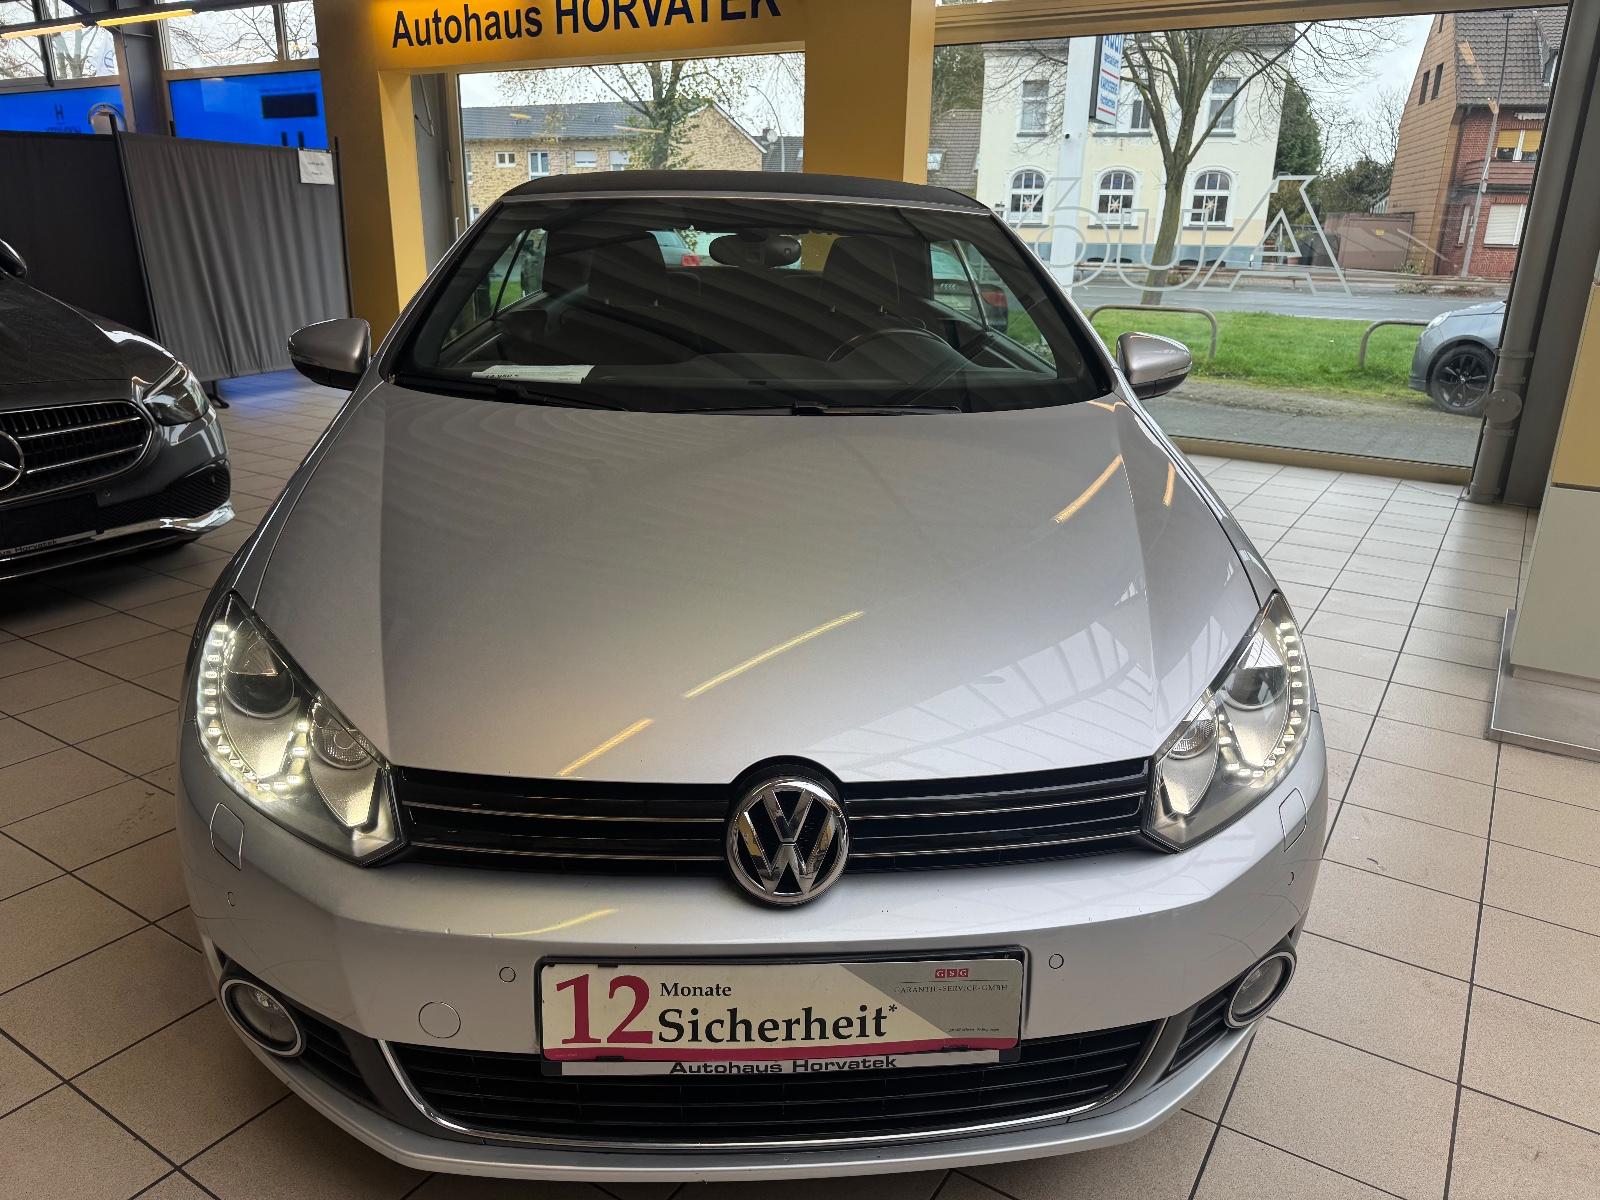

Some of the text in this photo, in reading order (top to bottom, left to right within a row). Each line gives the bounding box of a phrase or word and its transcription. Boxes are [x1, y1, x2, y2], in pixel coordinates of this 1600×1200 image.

[392, 3, 543, 48] Autohaus
[660, 982, 732, 997] Monate
[556, 973, 653, 1044] 12
[669, 1055, 898, 1075] Autohaus Horvatek
